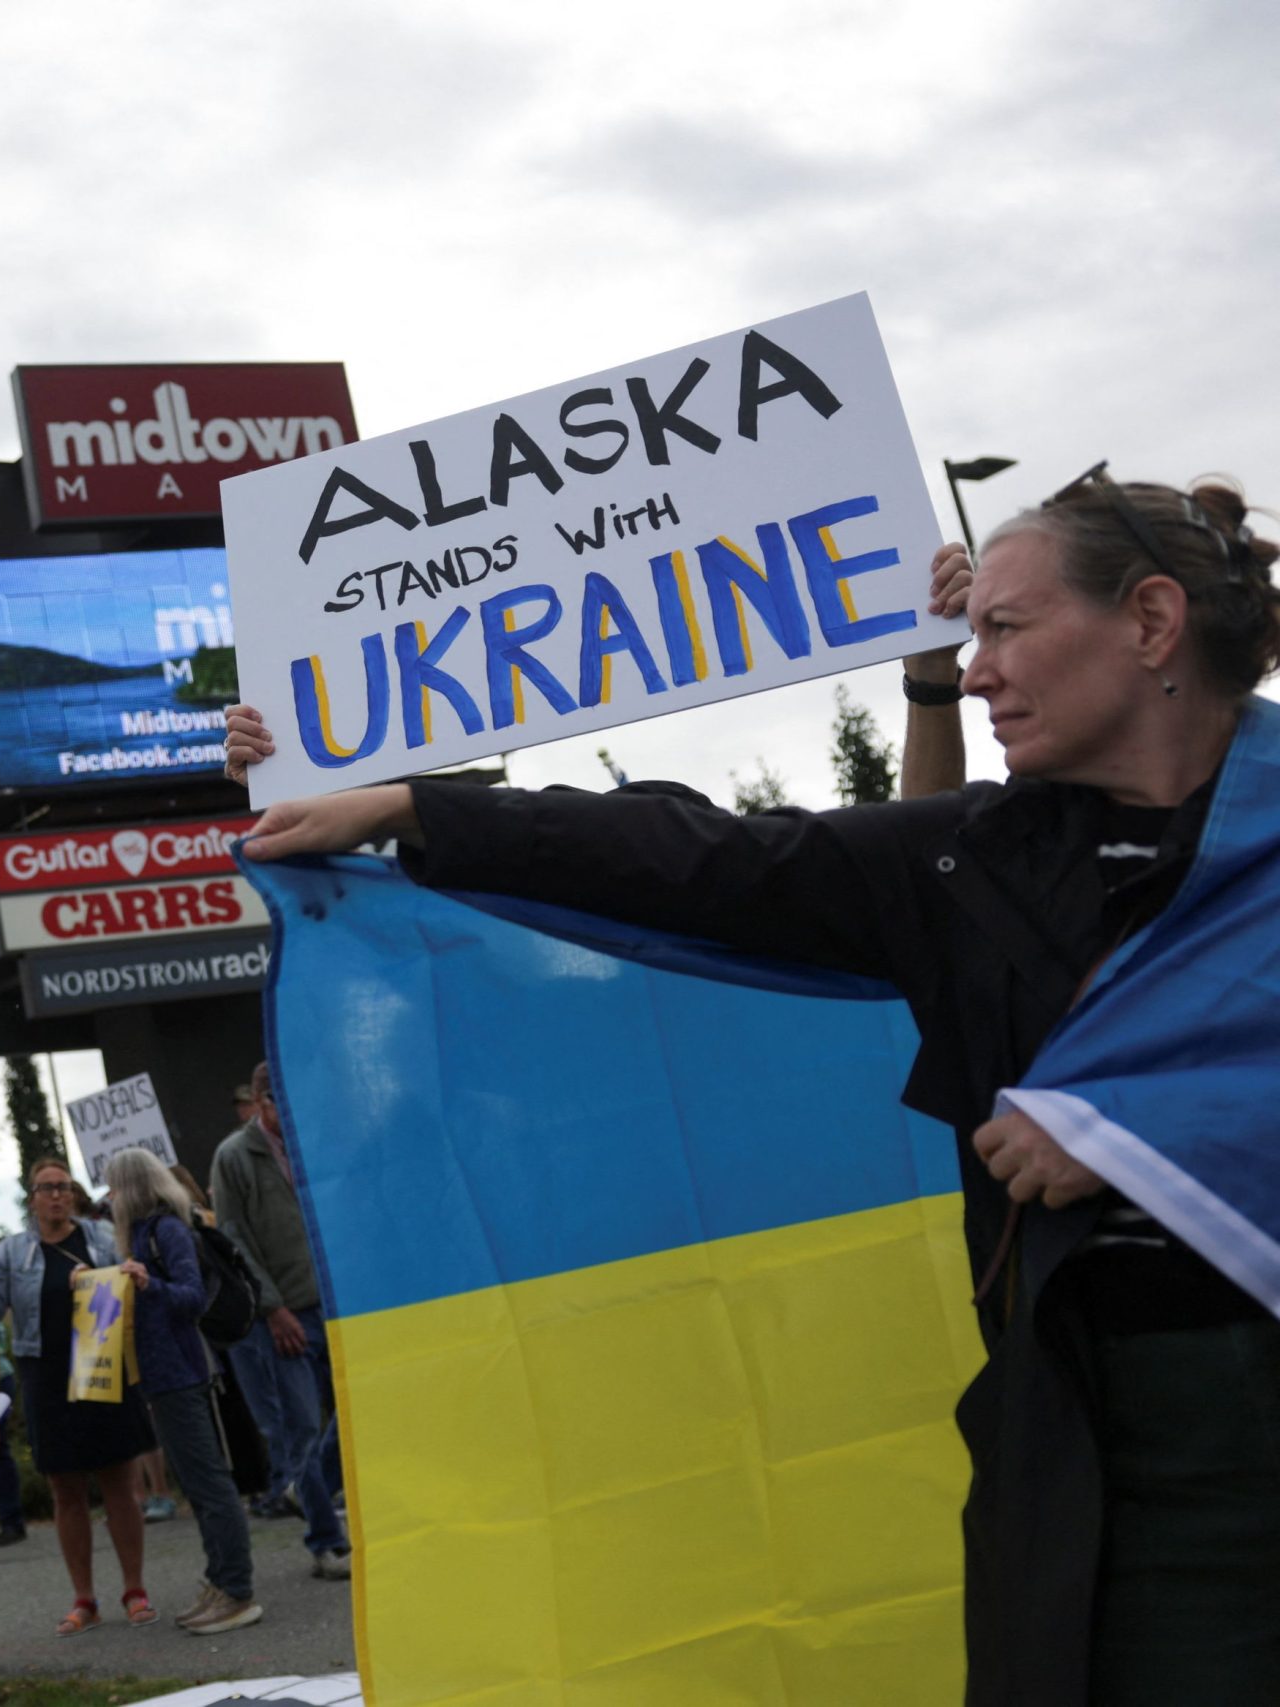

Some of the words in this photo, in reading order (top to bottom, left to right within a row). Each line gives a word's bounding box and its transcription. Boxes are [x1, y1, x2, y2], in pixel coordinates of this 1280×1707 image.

[46, 381, 344, 467] midtown
[298, 330, 843, 565] ALASKA
[323, 535, 519, 613] STANDS
[290, 495, 917, 769] UKRAINE
[121, 707, 226, 736] Midtown
[5, 839, 109, 881] Guitar
[150, 826, 249, 867] Cente
[41, 880, 243, 940] CARRS
[41, 958, 208, 999] NORDSTROM
